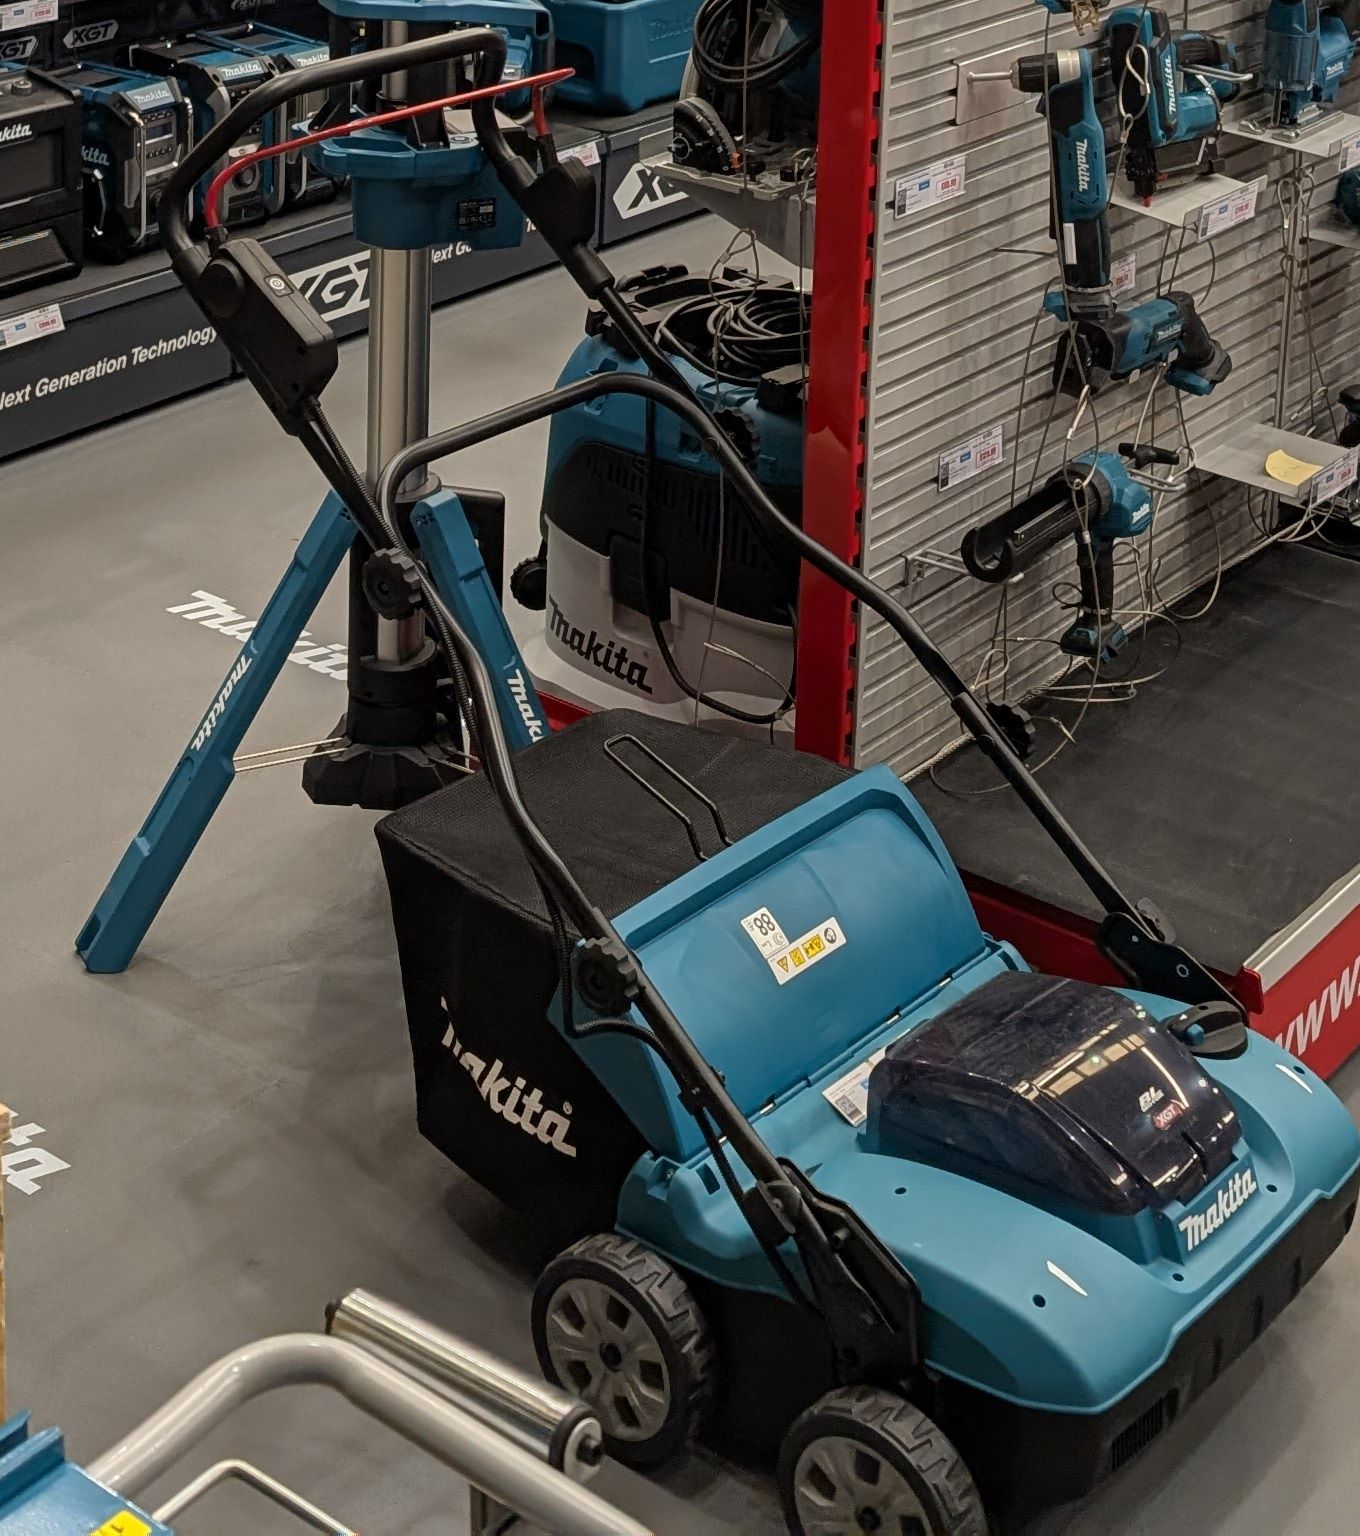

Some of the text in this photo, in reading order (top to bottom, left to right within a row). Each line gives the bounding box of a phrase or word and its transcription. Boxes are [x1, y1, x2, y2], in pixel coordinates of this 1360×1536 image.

[221, 61, 262, 78] Makita
[1168, 54, 1178, 116] Makita
[1075, 137, 1088, 193] Makita
[34, 352, 127, 399] Generation
[129, 324, 219, 366] Technology
[548, 594, 654, 696] Makita
[753, 912, 776, 937] 88
[1178, 1168, 1257, 1252] Makita
